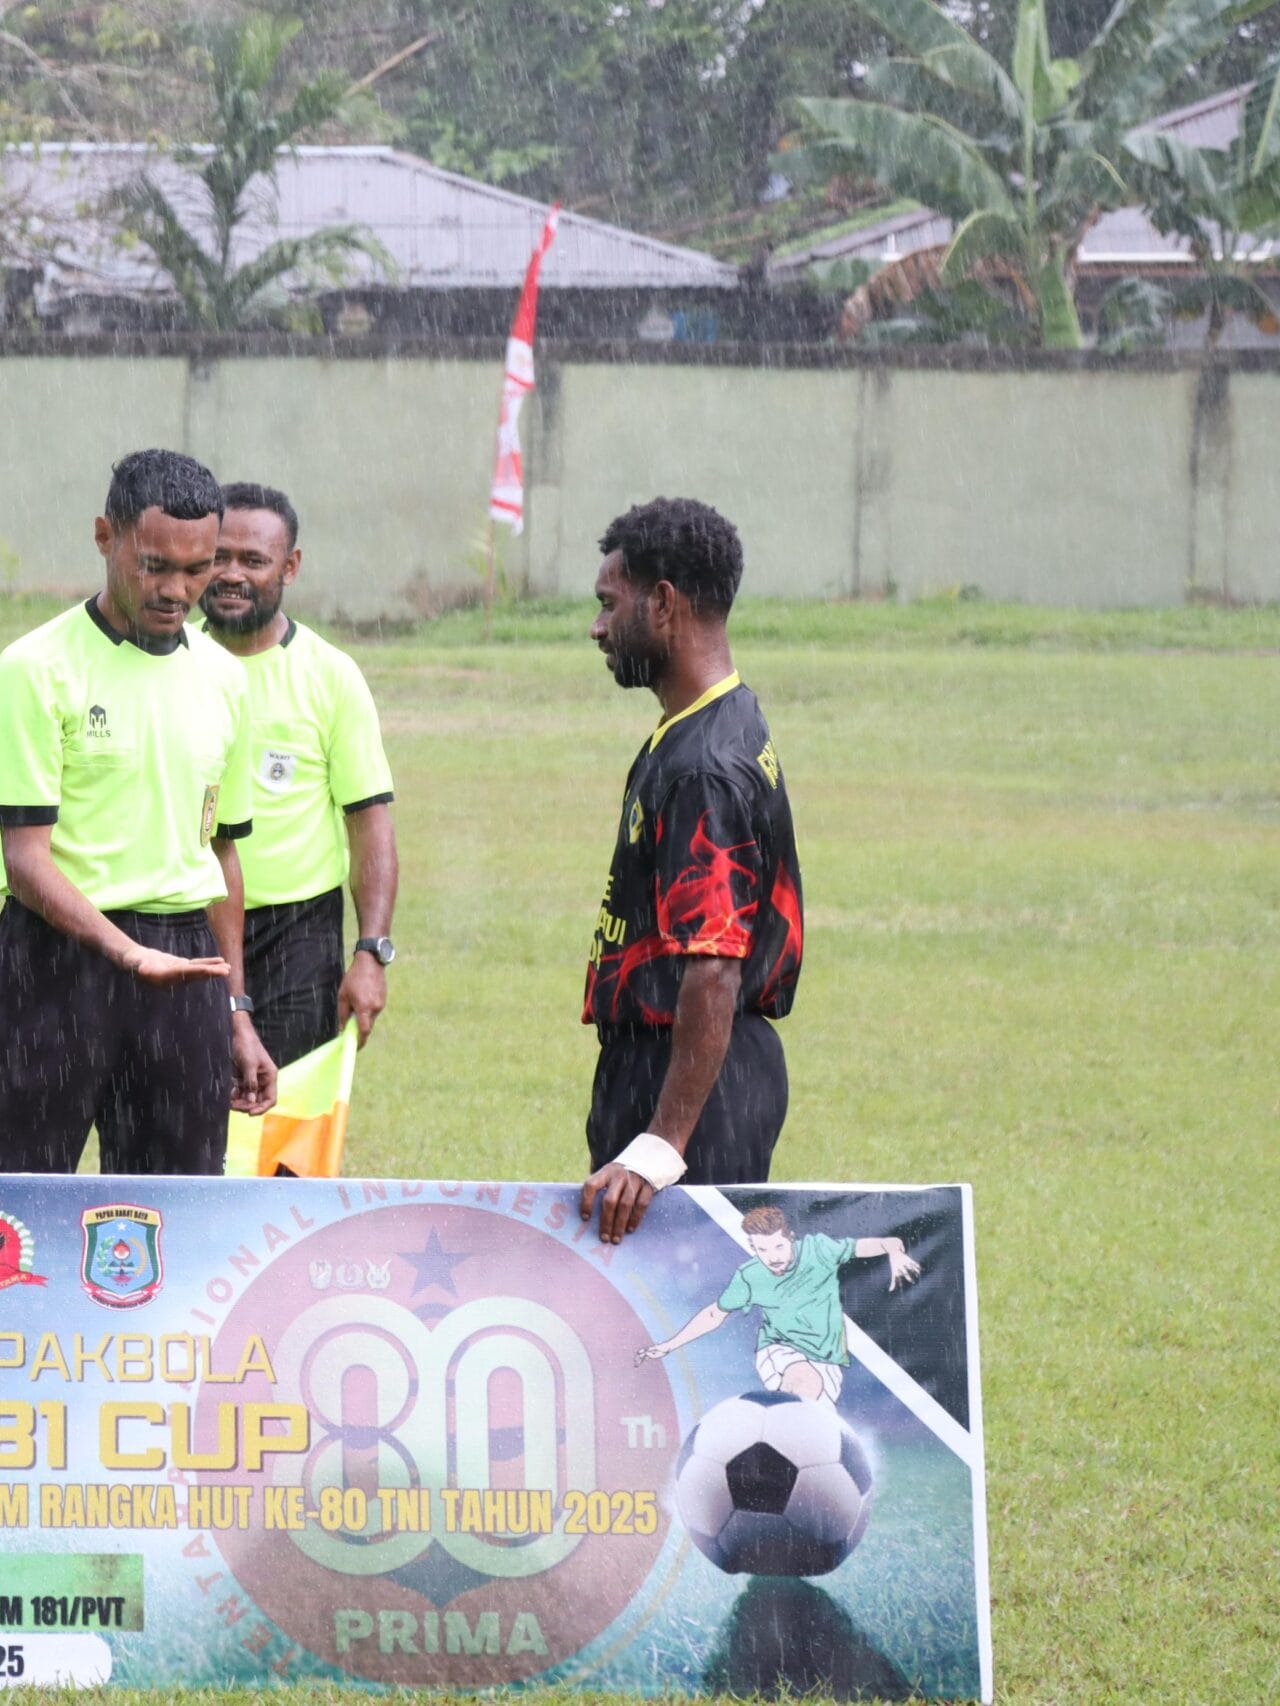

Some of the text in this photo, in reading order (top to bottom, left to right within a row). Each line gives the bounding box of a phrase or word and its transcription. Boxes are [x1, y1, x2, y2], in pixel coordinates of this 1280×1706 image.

[86, 729, 111, 738] MILLS
[0, 1273, 27, 1287] TAMA
[98, 1400, 311, 1472] CUP
[272, 1294, 599, 1577] 80
[621, 1413, 667, 1449] Th
[39, 1484, 178, 1529] RANGKA
[187, 1486, 253, 1530] HUT
[263, 1486, 368, 1532] KE-80
[376, 1487, 431, 1533] TNI
[440, 1488, 554, 1534] TAHUN
[563, 1490, 658, 1535] 2025
[30, 1596, 126, 1627] 181/PVT
[333, 1608, 549, 1656] PRIMA
